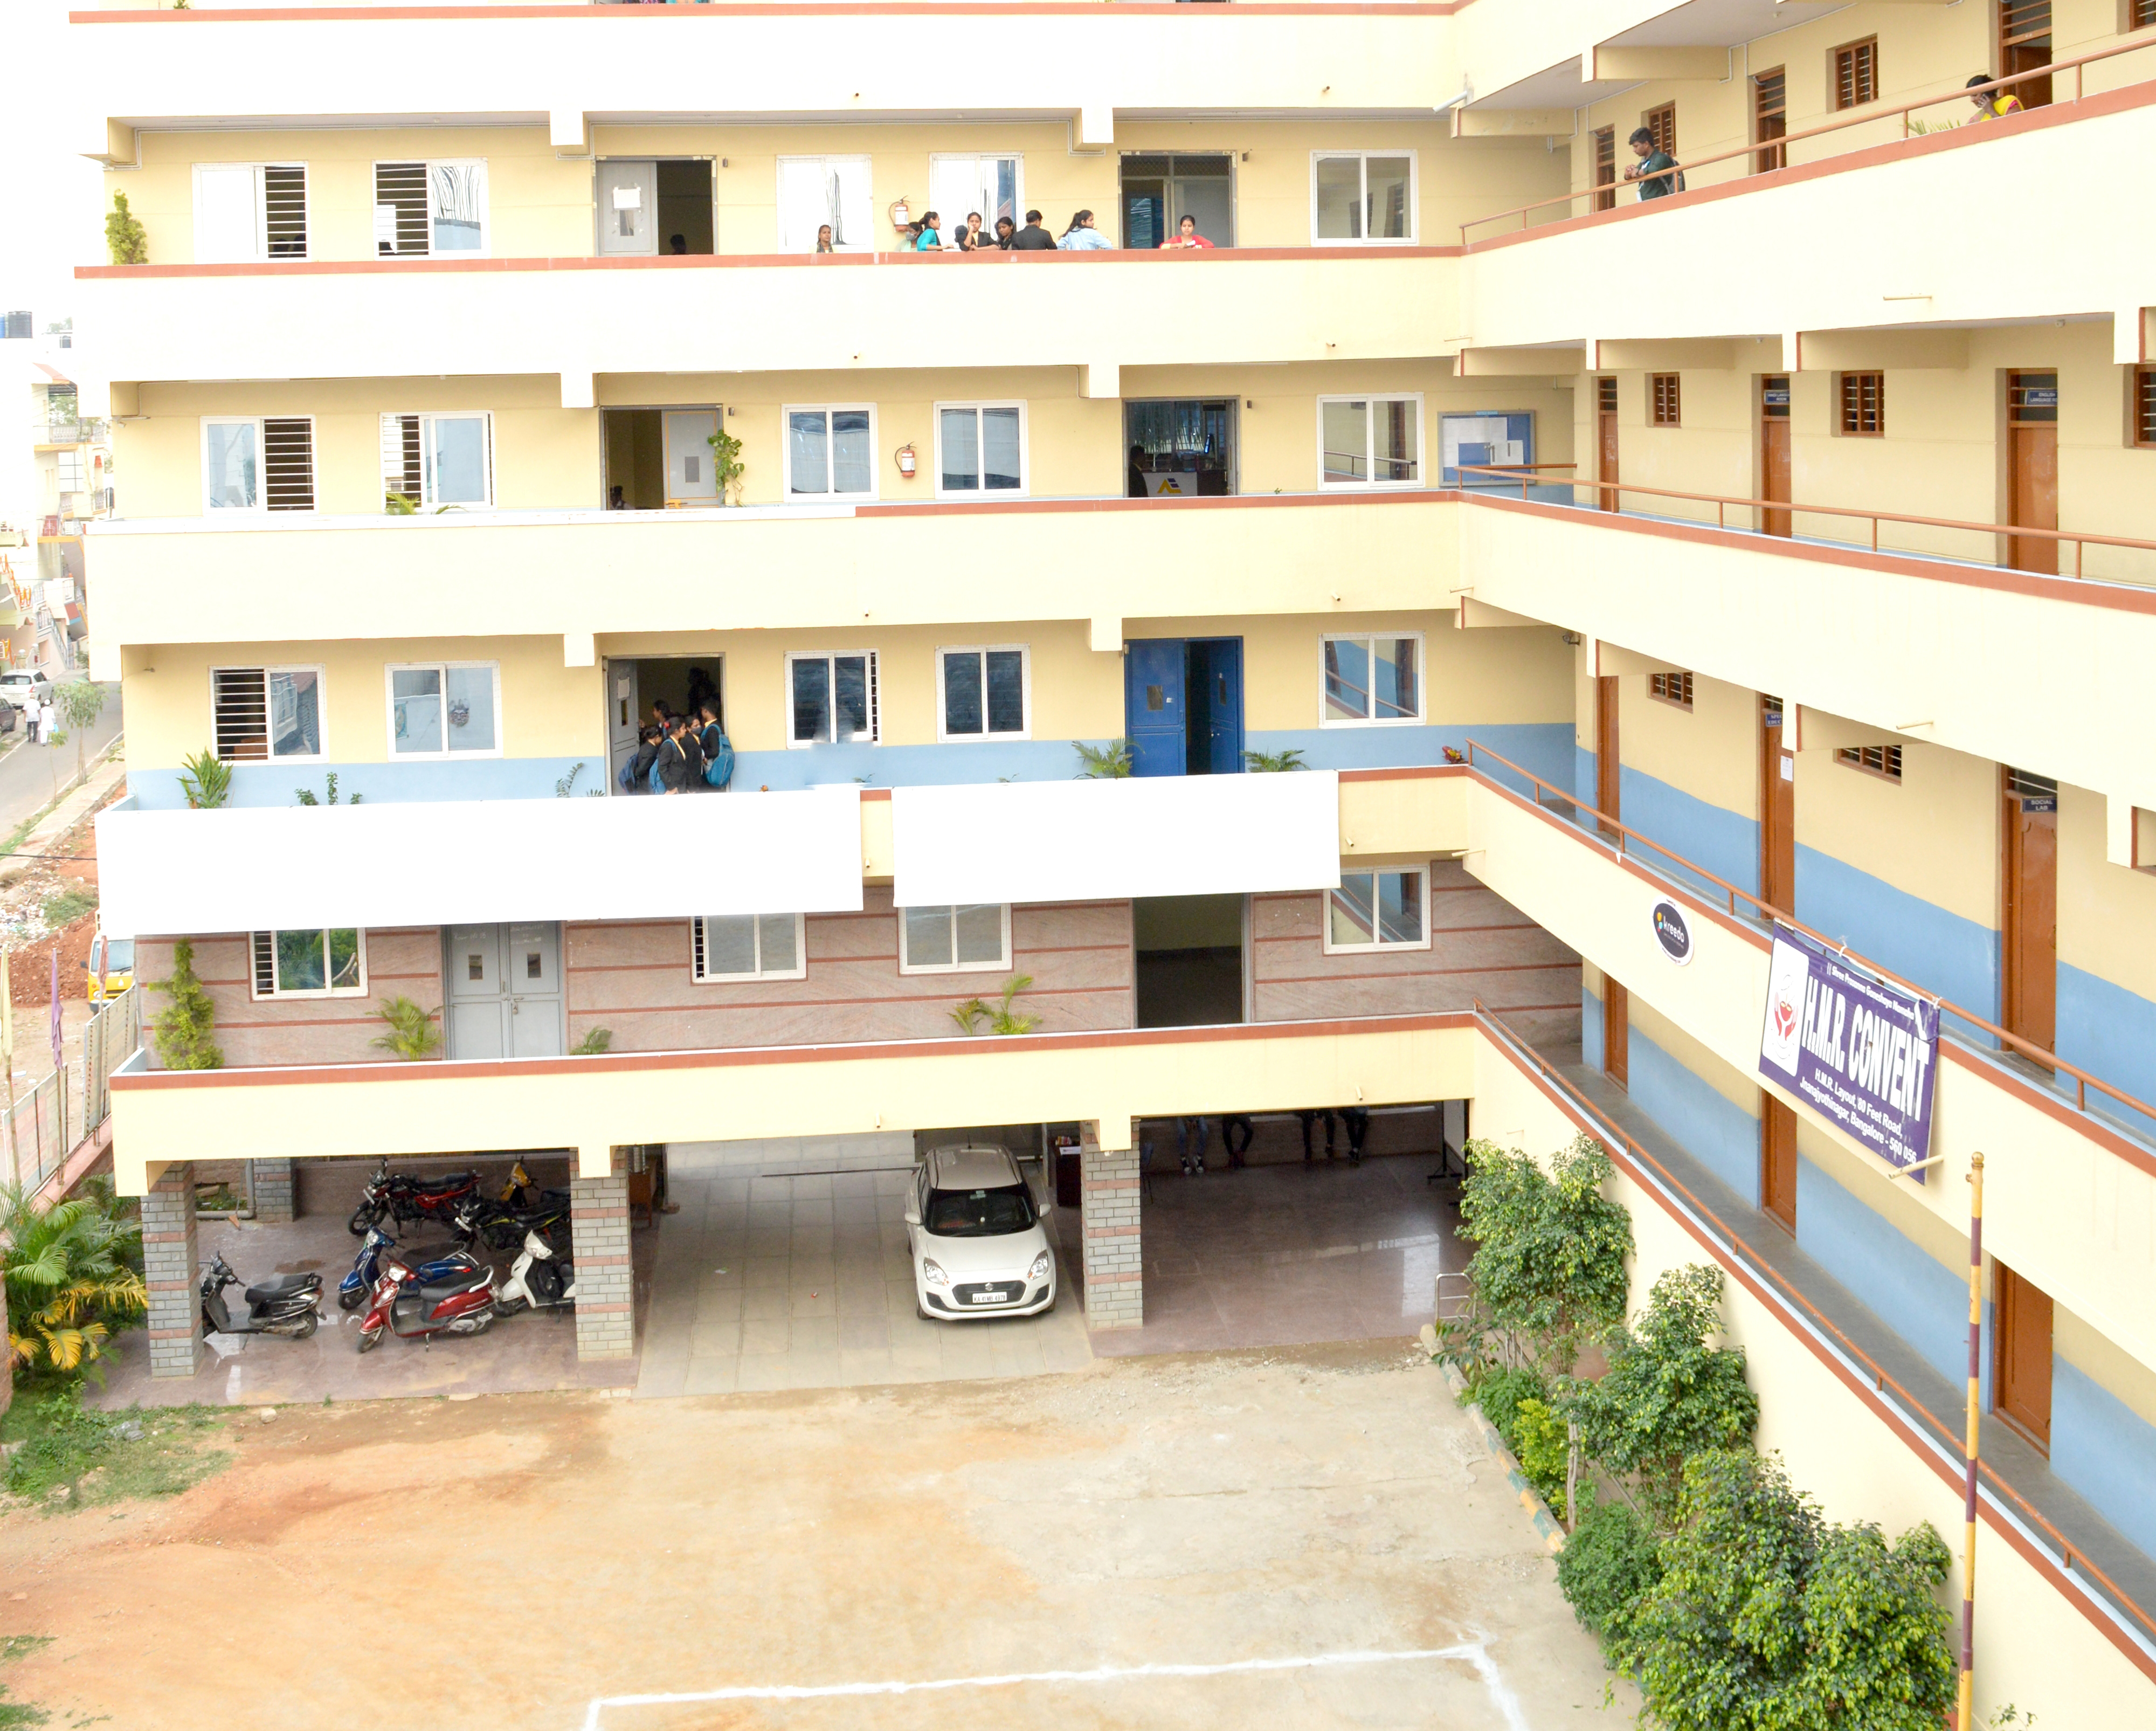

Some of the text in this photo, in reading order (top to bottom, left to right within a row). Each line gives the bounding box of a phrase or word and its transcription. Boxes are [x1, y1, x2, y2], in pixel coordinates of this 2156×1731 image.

[1663, 915, 1684, 943] kreedo
[1802, 975, 1930, 1122] H.M.R. CONVENT
[1815, 1067, 1902, 1139] H.M.R. Layout, 80 Feet Road,
[1850, 1111, 1885, 1144] Bangalore
[1889, 1136, 1903, 1156] 560
[1903, 1146, 1917, 1164] 056
